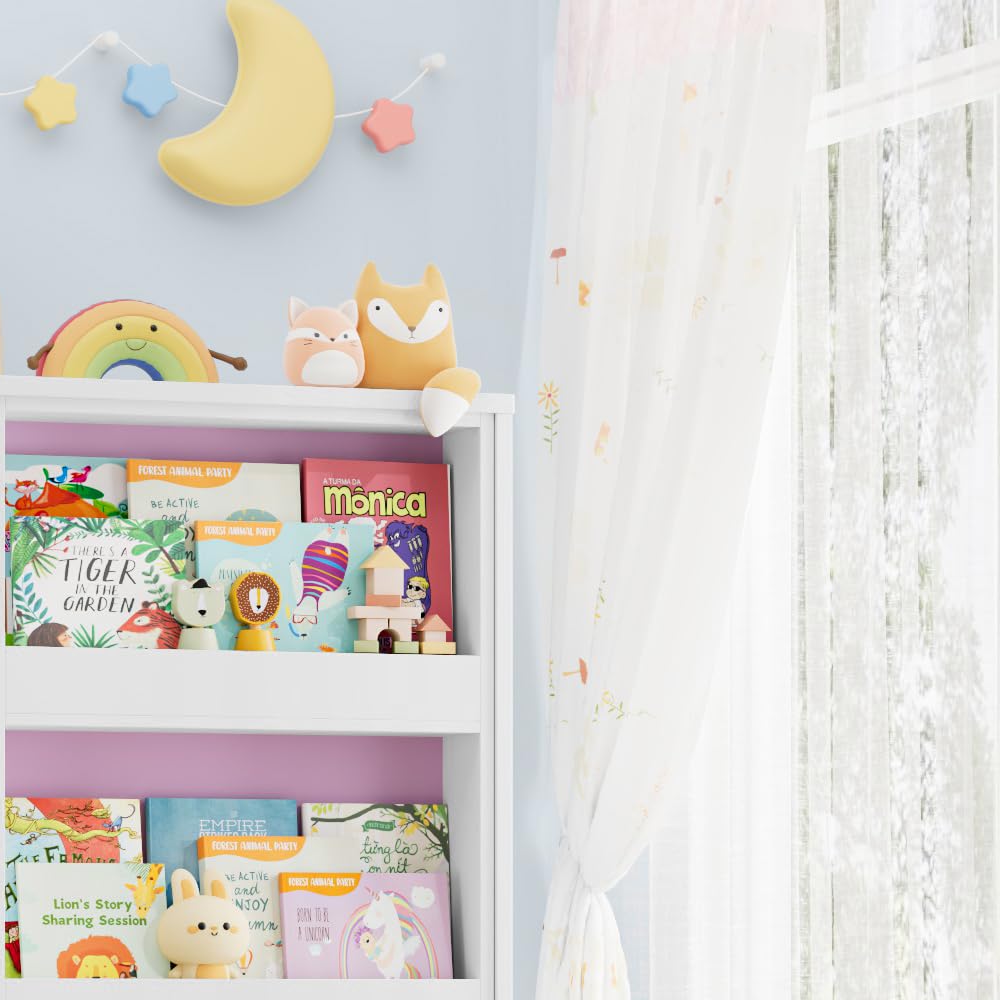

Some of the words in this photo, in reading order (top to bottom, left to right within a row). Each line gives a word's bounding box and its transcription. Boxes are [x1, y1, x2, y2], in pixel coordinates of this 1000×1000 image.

[137, 465, 168, 476] FOREST
[168, 466, 205, 477] ANIMAL
[205, 467, 233, 479] PARTY
[150, 500, 164, 509] BE
[166, 497, 201, 509] ACTIVE
[59, 557, 137, 585] TIGER
[75, 583, 87, 595] IN
[95, 584, 119, 596] THE
[63, 596, 135, 614] GARDEN
[199, 819, 267, 832] EMPIRE
[211, 841, 238, 851] FOREST
[240, 841, 273, 852] ANIMAL
[274, 842, 298, 852] PARTY
[238, 871, 270, 881] ACTIVE
[234, 882, 260, 896] and
[53, 898, 90, 910] Lion's
[95, 899, 133, 913] Story
[231, 897, 269, 912] NJOY
[41, 914, 94, 929] Sharing
[98, 914, 148, 926] Session
[296, 906, 312, 923] BORN
[304, 926, 331, 942] UNICORN
